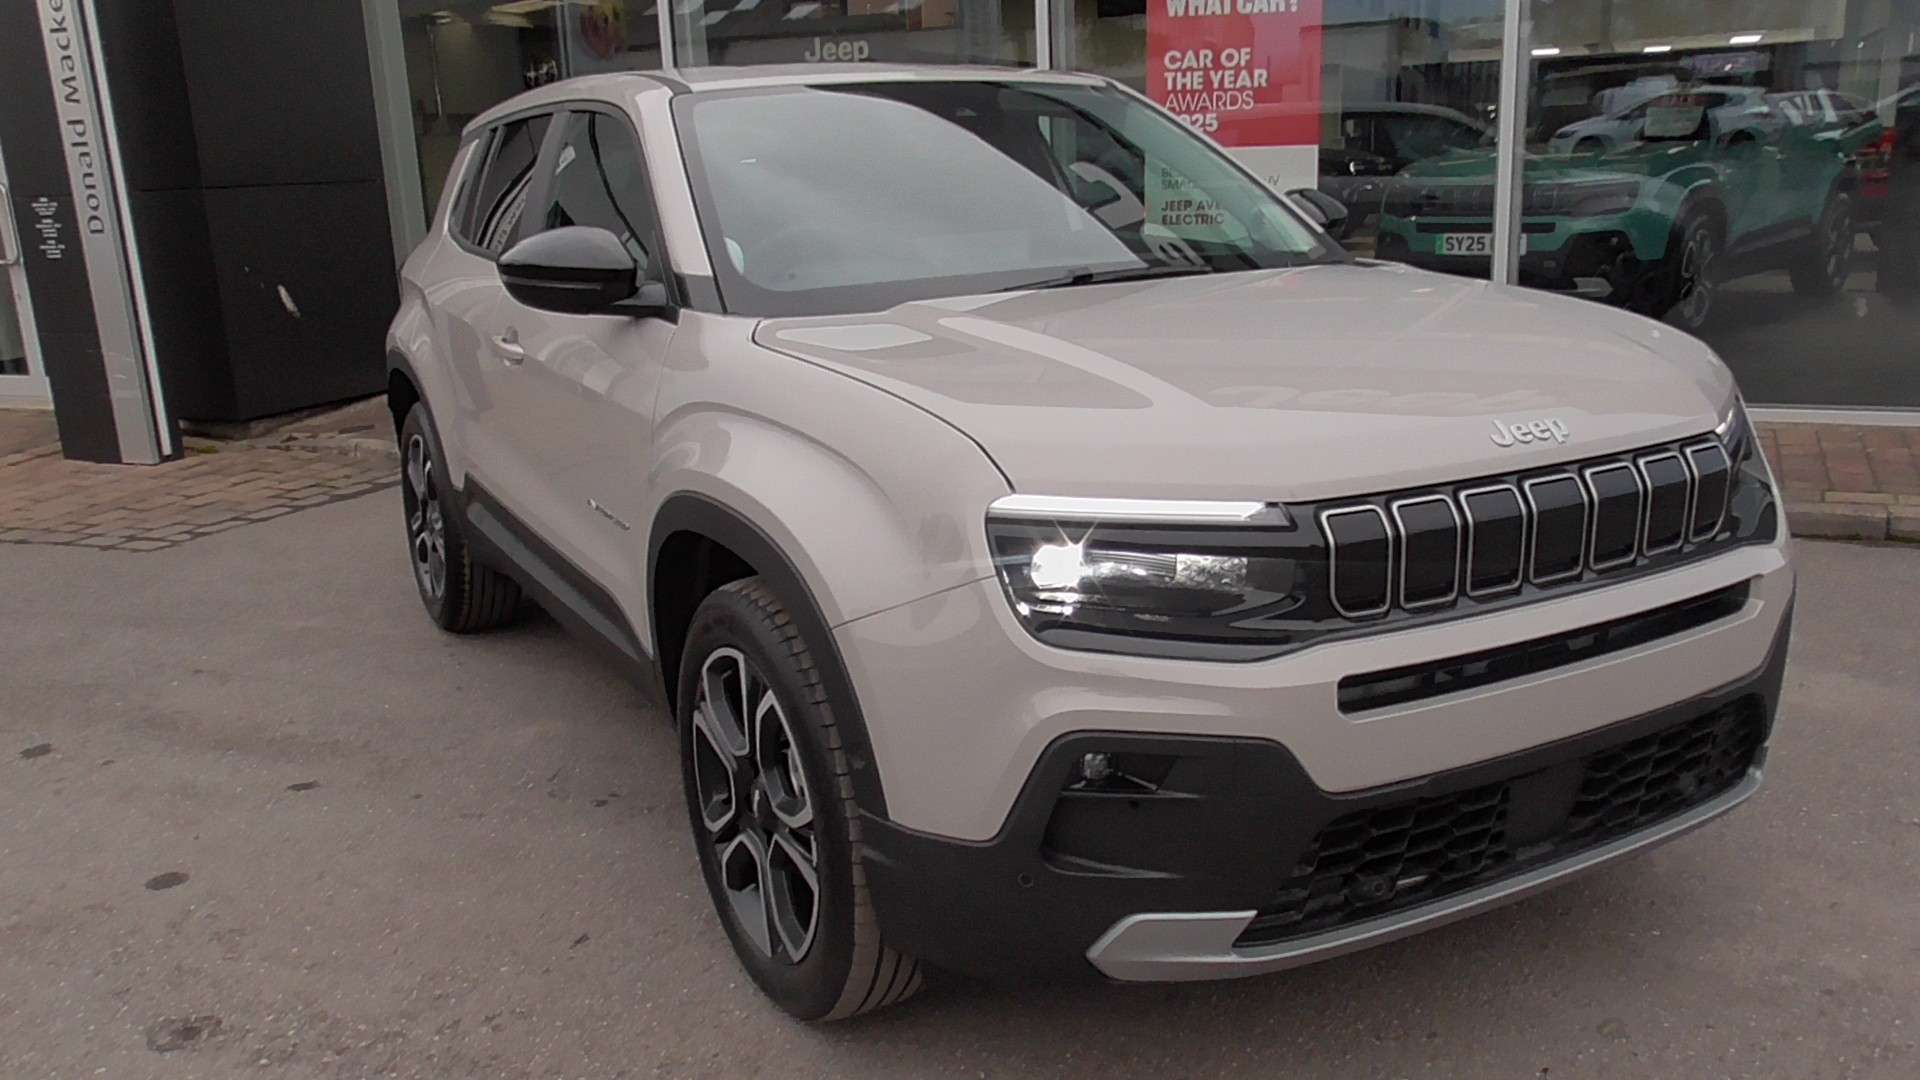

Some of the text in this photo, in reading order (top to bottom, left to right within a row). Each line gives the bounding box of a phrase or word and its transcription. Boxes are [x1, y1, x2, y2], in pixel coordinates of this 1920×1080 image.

[804, 36, 869, 62] Jeep
[1163, 48, 1251, 69] CAR OF
[1164, 69, 1268, 90] THE YEAR
[1164, 91, 1254, 112] AWARDS
[1178, 113, 1219, 132] 025
[66, 119, 104, 234] Donald
[1161, 200, 1193, 212] JEEP
[1161, 213, 1225, 225] ELECTRIC
[1445, 236, 1486, 252] SY25
[1489, 418, 1568, 447] Jeep
